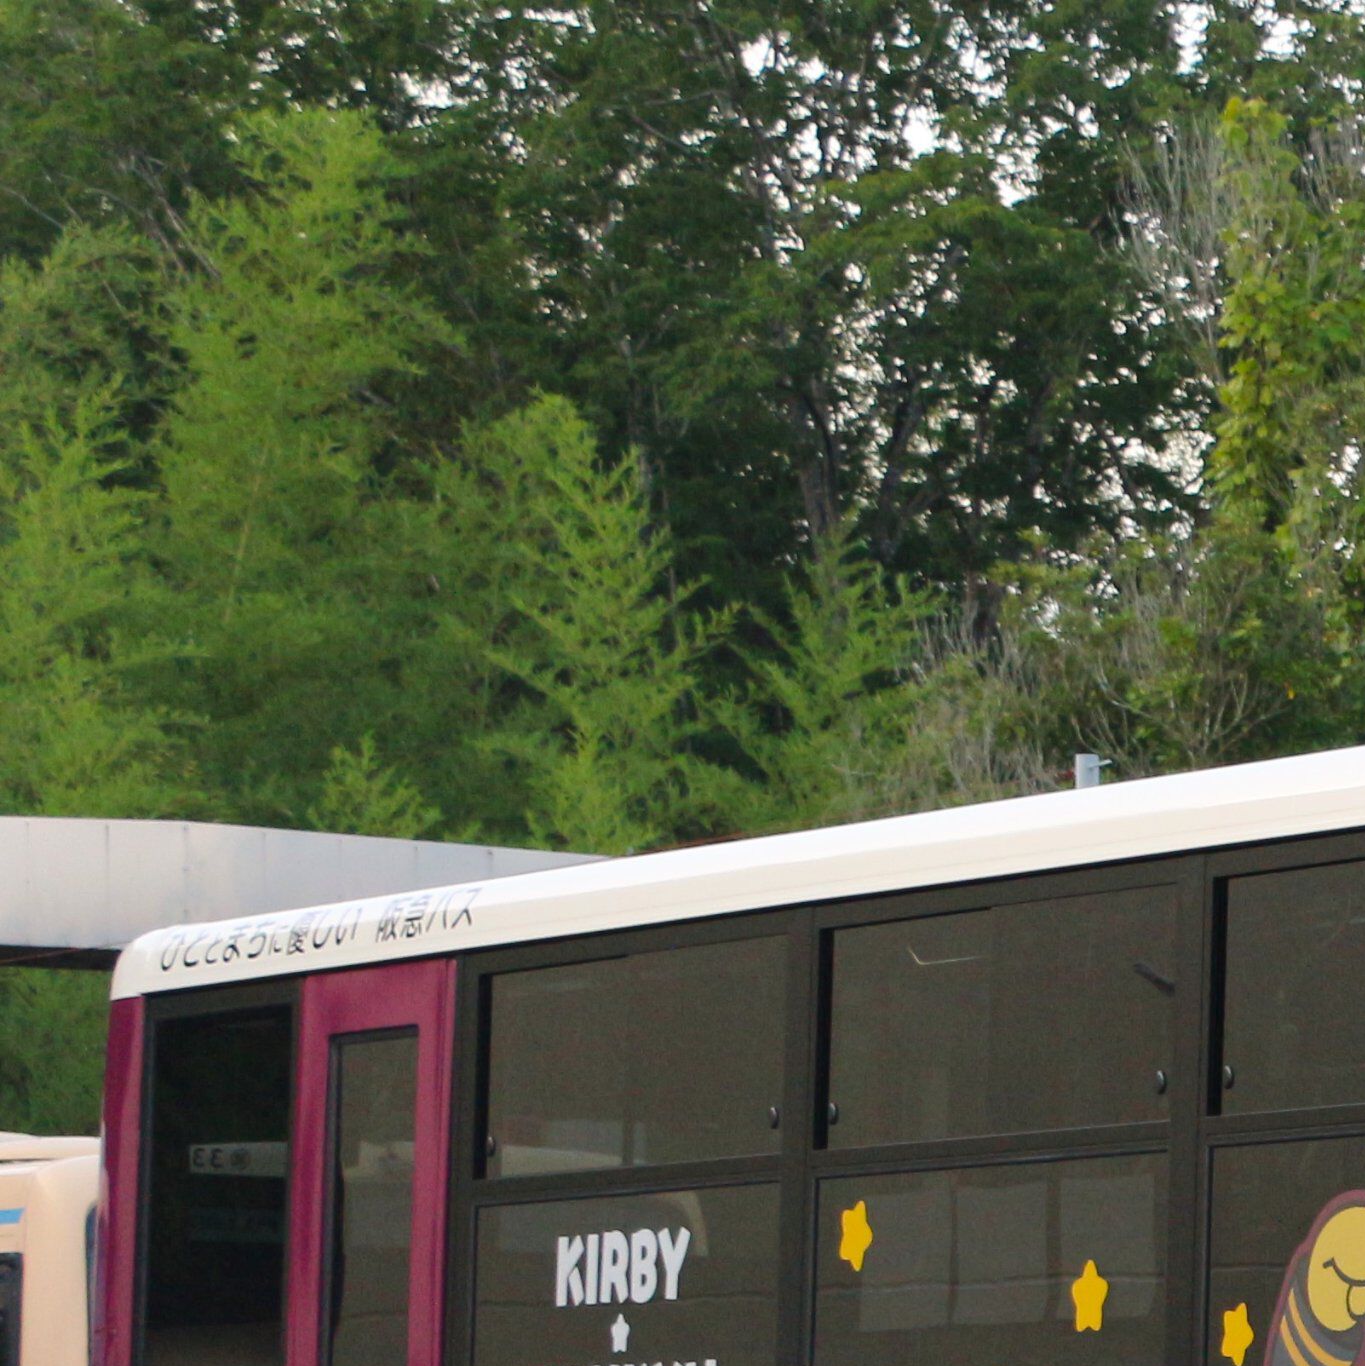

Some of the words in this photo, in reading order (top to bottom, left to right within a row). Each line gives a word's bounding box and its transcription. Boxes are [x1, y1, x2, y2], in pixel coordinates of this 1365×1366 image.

[374, 887, 481, 943] 阪急バス
[555, 1226, 691, 1307] KIRBY
